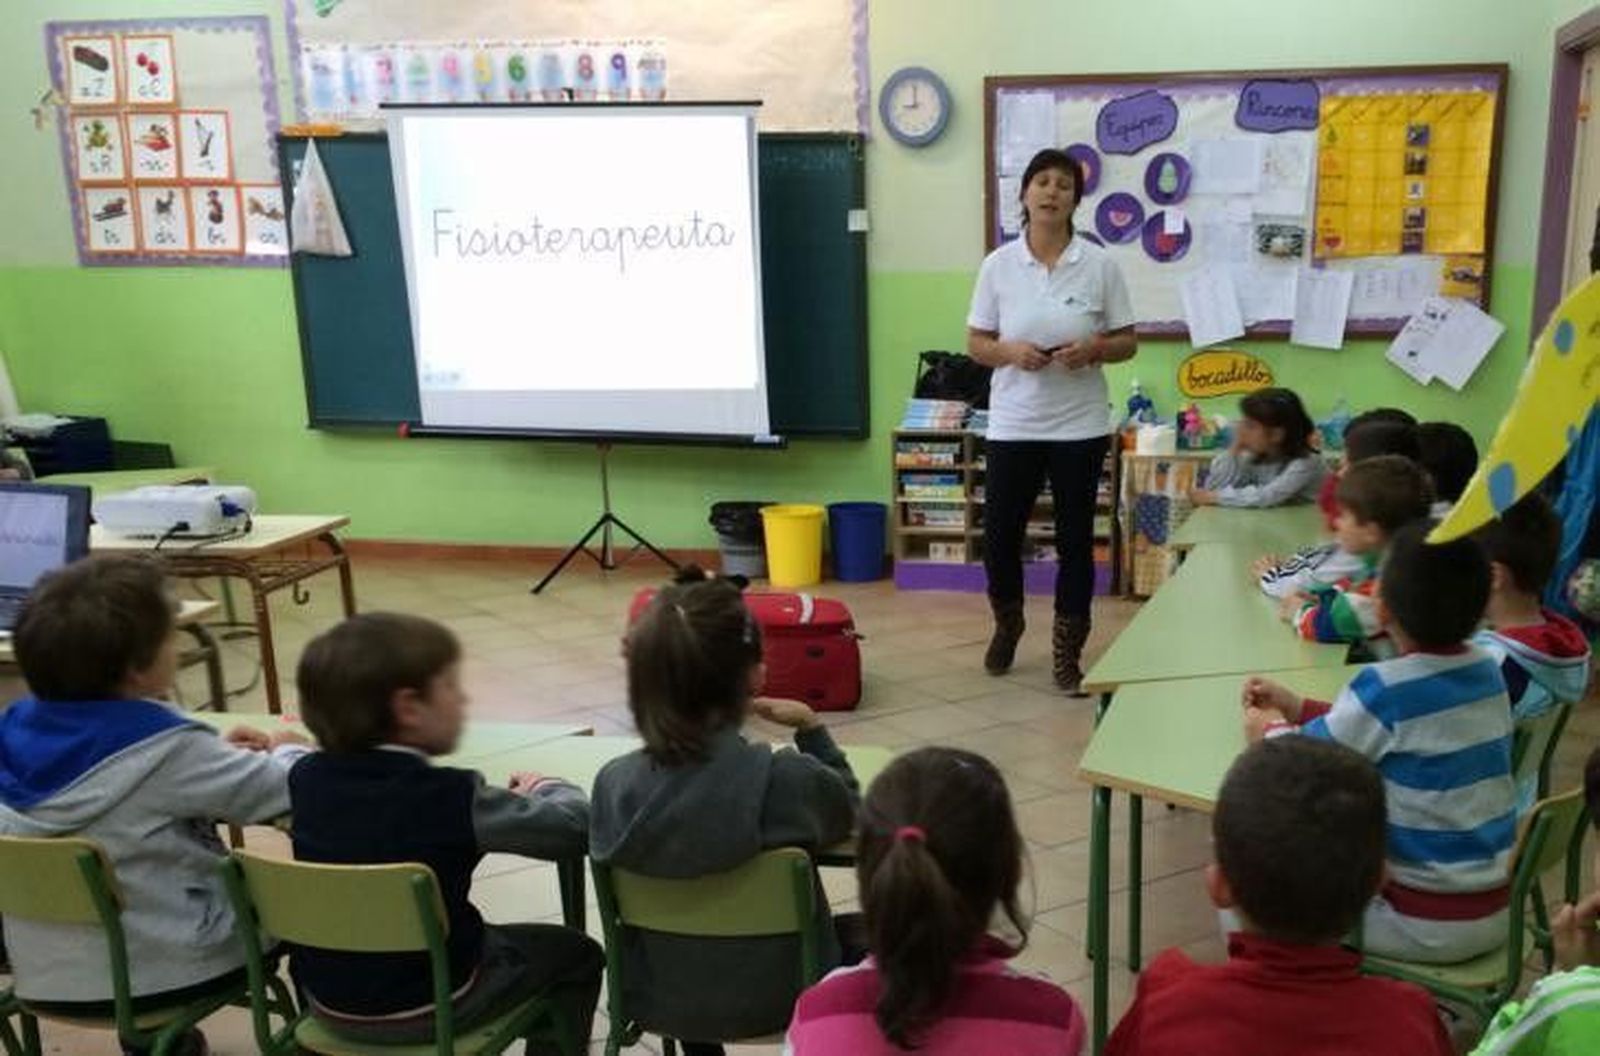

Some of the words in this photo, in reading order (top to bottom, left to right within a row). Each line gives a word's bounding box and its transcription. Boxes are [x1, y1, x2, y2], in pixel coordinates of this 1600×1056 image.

[507, 53, 527, 82] 6
[577, 53, 595, 82] 8
[610, 52, 627, 81] 9
[431, 207, 736, 275] Fisioterapeuta
